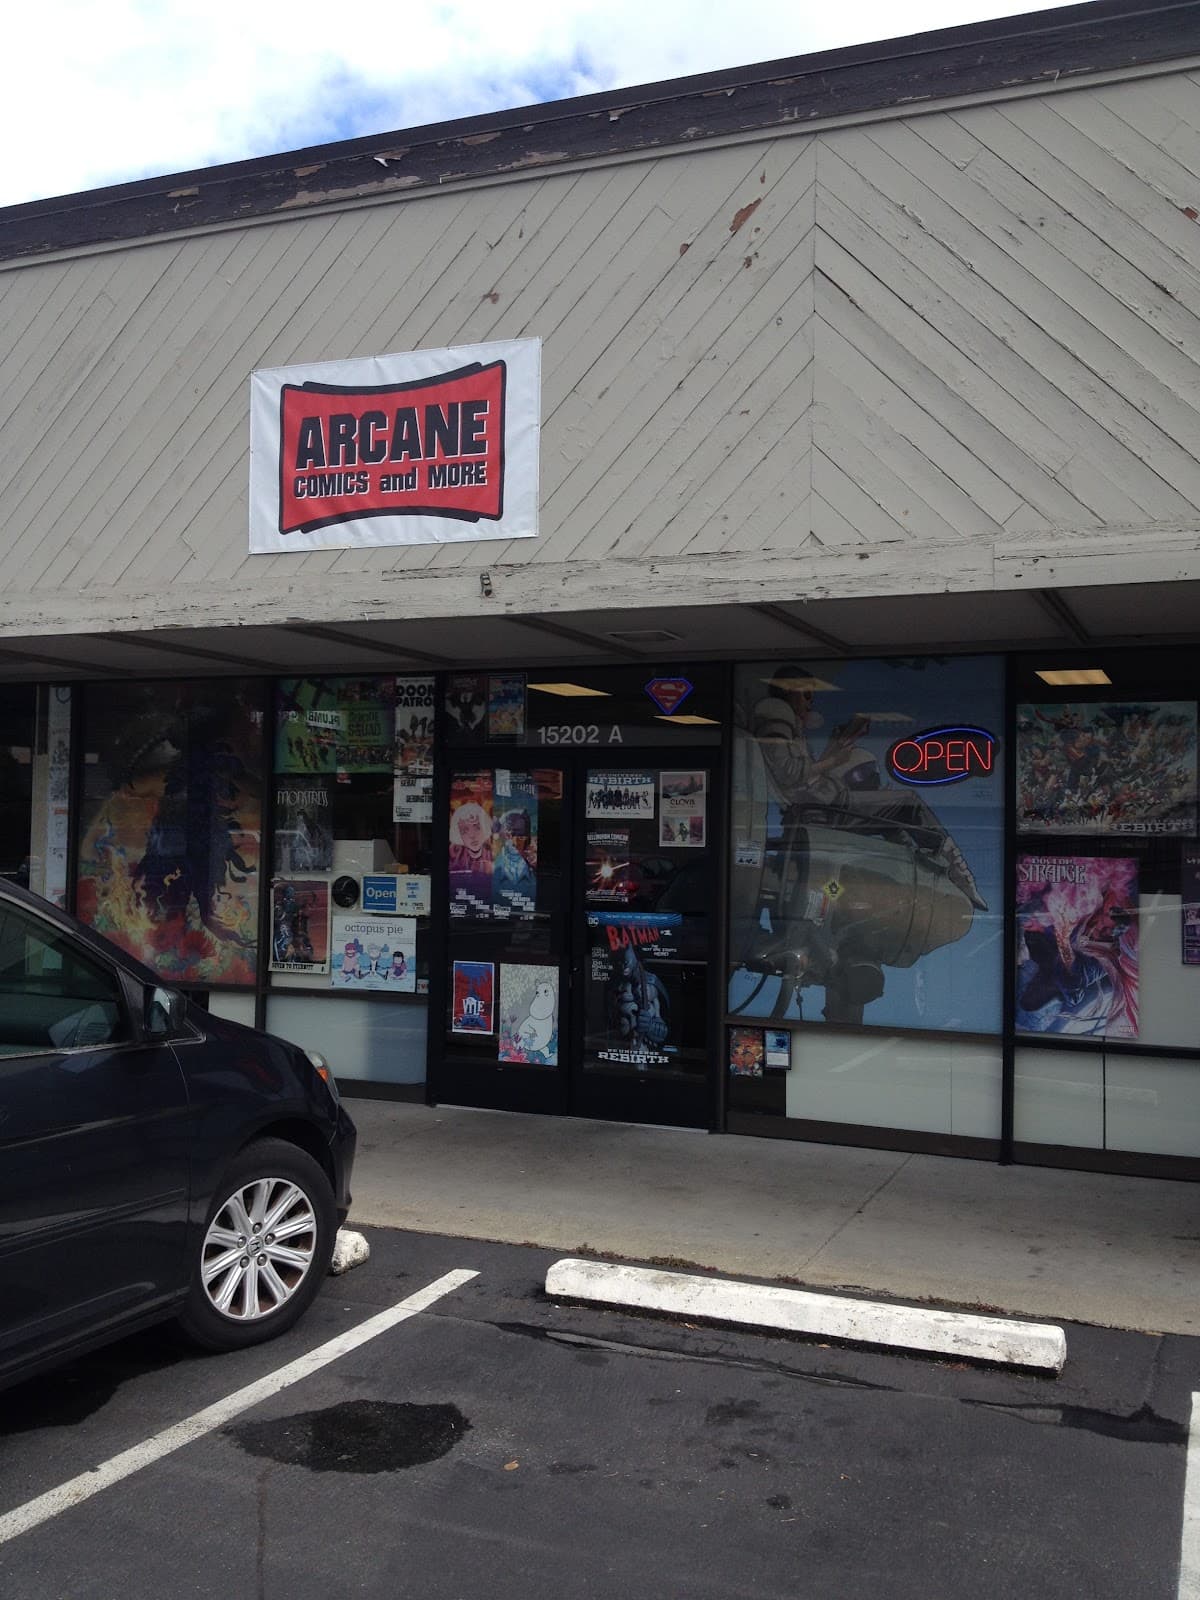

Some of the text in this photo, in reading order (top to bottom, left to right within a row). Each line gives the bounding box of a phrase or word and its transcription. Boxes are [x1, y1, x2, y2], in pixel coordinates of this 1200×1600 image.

[295, 400, 490, 471] ARCANE
[293, 461, 488, 499] COMICS and MORE
[537, 724, 623, 744] 15202 A
[891, 739, 993, 772] OPEN
[366, 886, 397, 900] Open
[344, 924, 404, 936] octopus pie
[605, 924, 660, 952] BATMAN
[597, 1050, 670, 1064] REBIRTH
